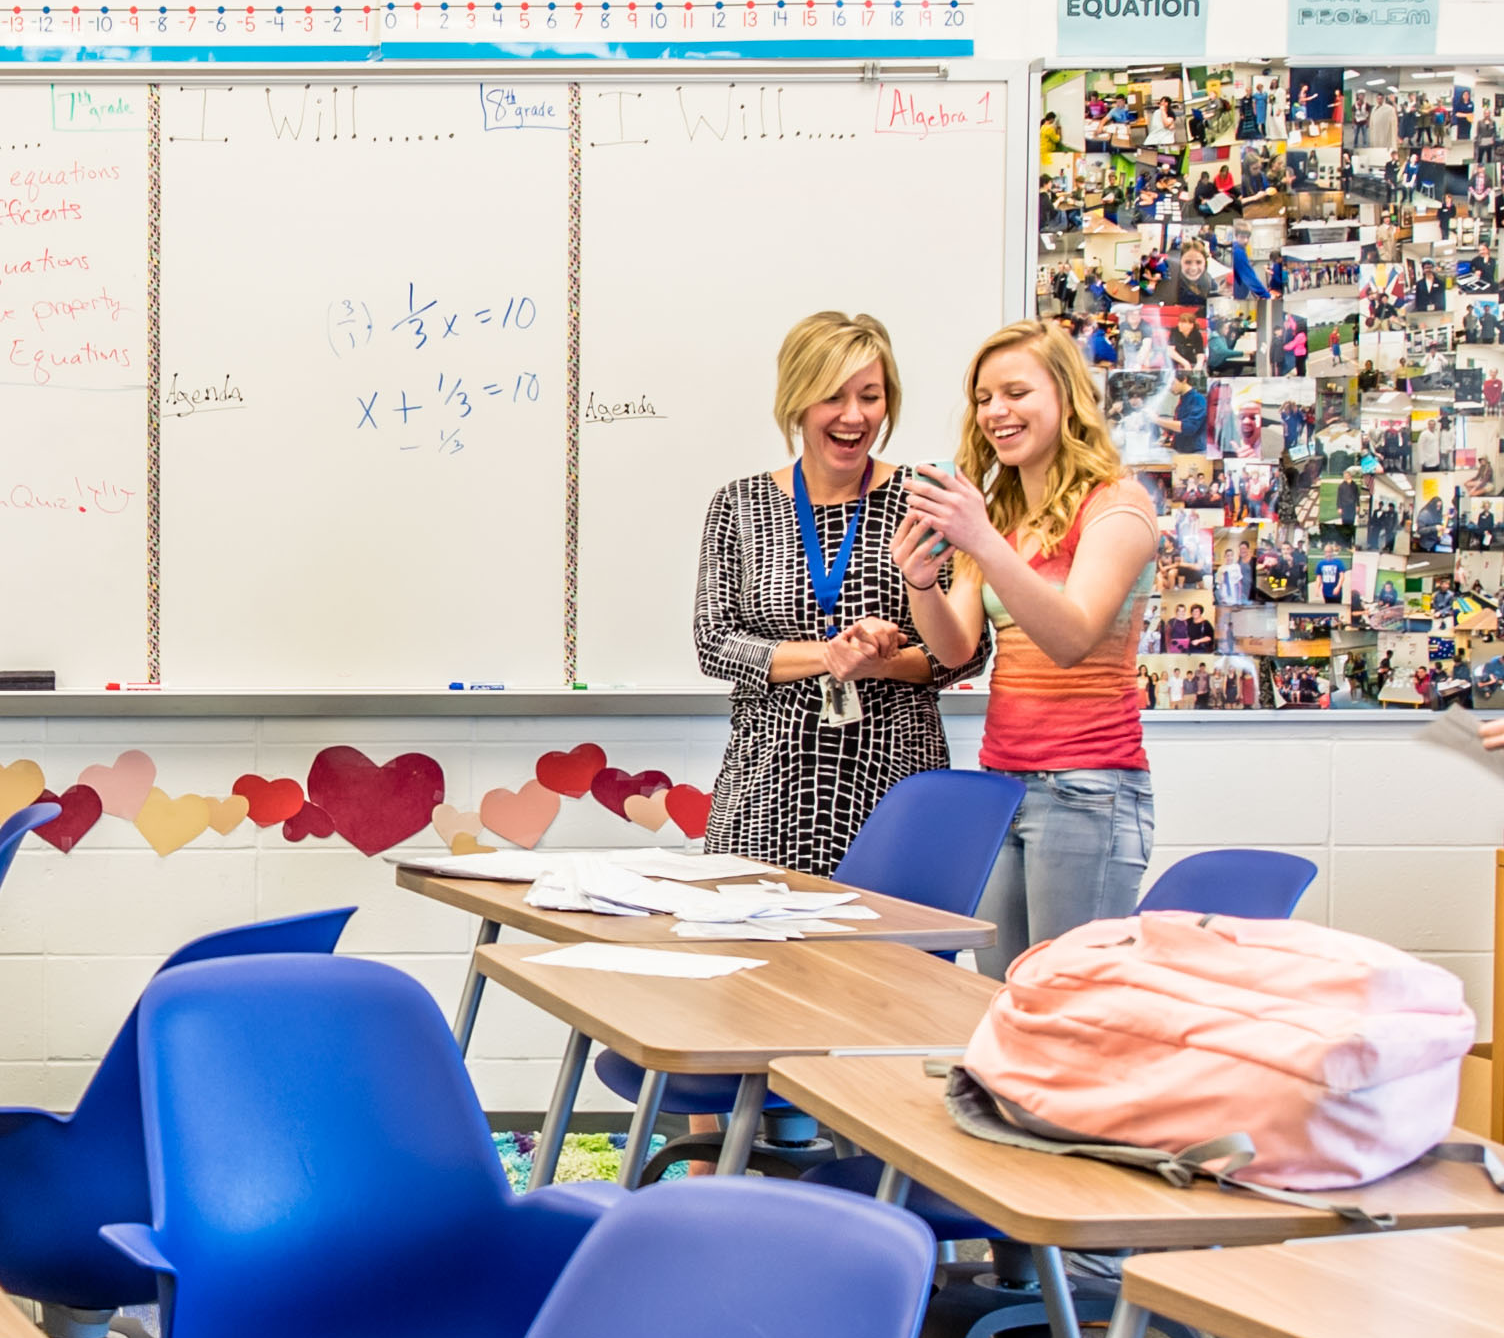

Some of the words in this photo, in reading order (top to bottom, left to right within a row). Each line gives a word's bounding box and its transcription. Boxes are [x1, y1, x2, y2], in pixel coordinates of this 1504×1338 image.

[773, 12, 787, 27] 14
[802, 11, 817, 26] 15
[862, 11, 875, 26] 17
[944, 11, 964, 26] 20
[515, 97, 555, 128] grade
[890, 88, 967, 140] Algebra
[976, 91, 993, 124] 1
